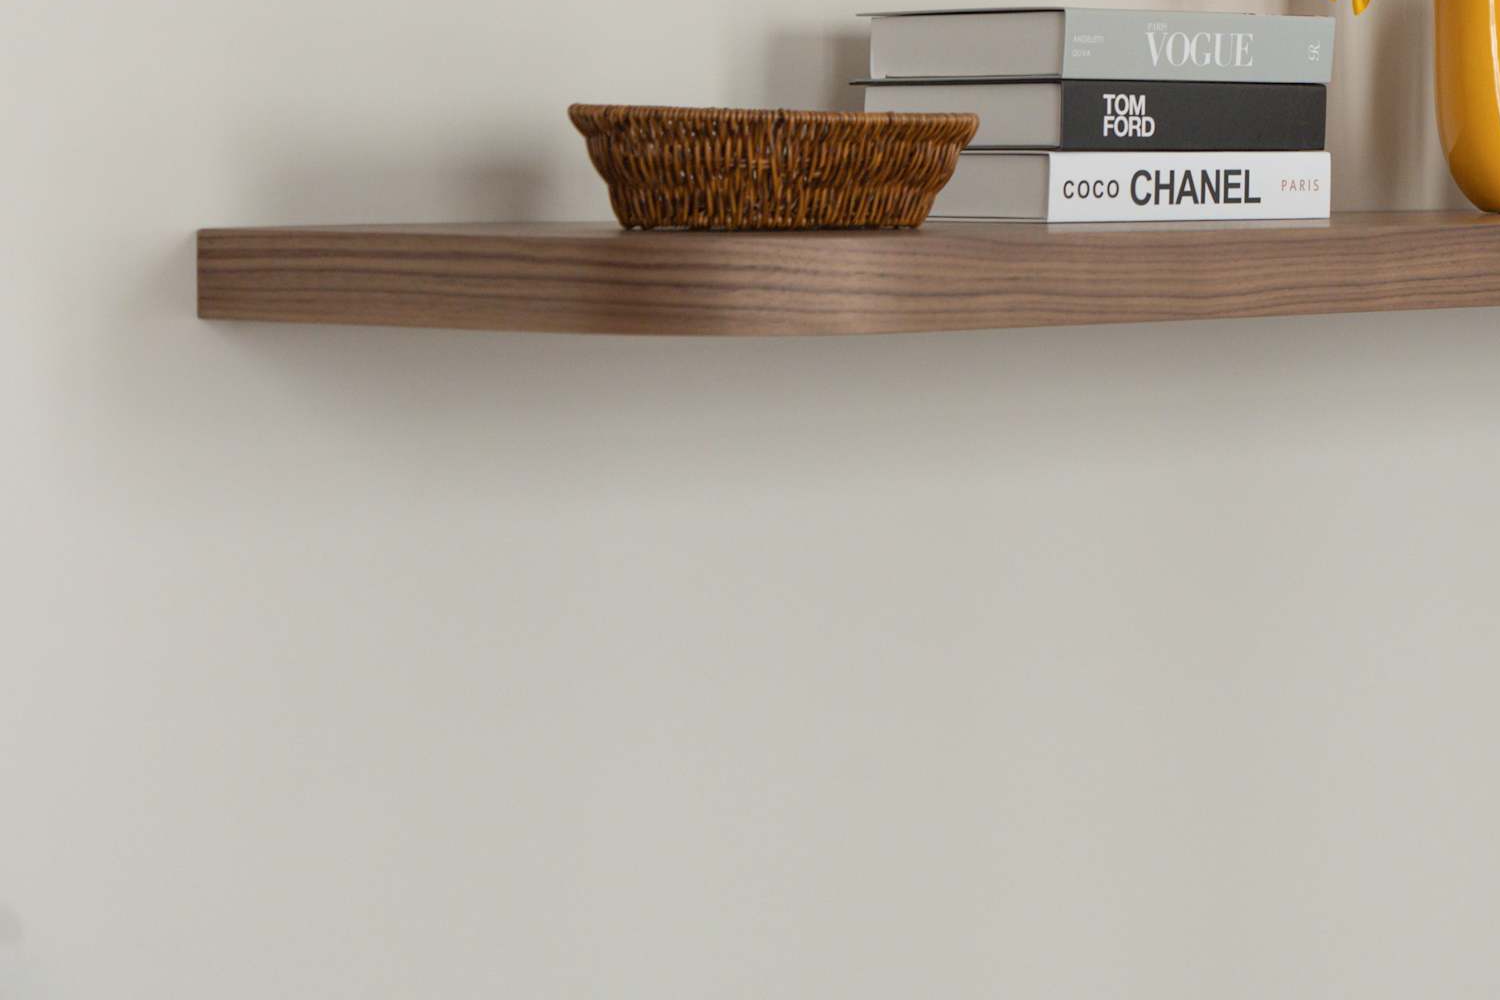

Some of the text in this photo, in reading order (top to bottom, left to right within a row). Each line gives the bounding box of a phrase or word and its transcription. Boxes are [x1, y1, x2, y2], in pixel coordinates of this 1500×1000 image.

[1146, 32, 1254, 67] VOGUE
[1103, 94, 1146, 116] TOM
[1103, 115, 1155, 137] FORD
[1063, 168, 1320, 206] COCO CHANEL PARIS
